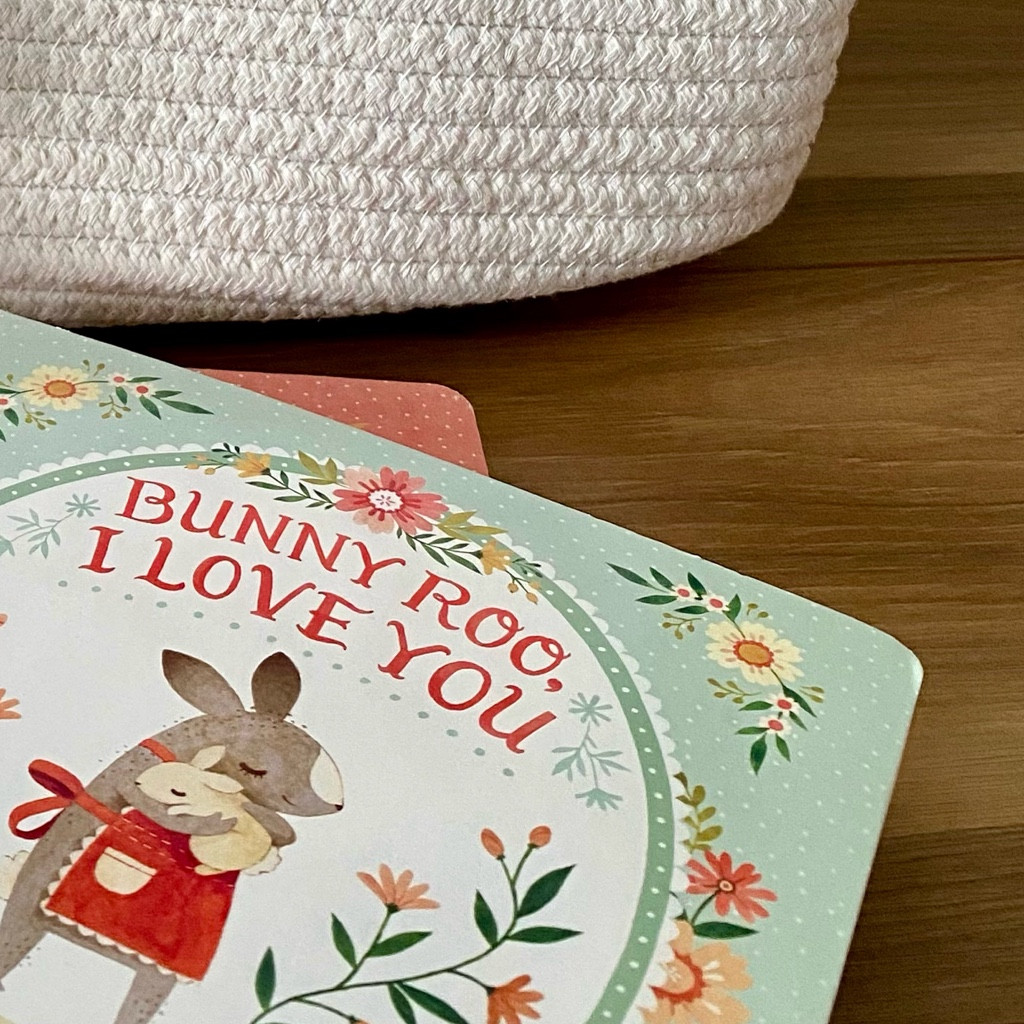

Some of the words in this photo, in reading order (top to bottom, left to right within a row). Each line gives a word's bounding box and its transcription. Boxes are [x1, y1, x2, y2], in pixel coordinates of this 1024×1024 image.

[78, 525, 124, 574] I
[134, 536, 374, 651] LOVE
[377, 620, 557, 754] YOU
[115, 476, 406, 588] BUNNY
[401, 570, 571, 693] ROO,
